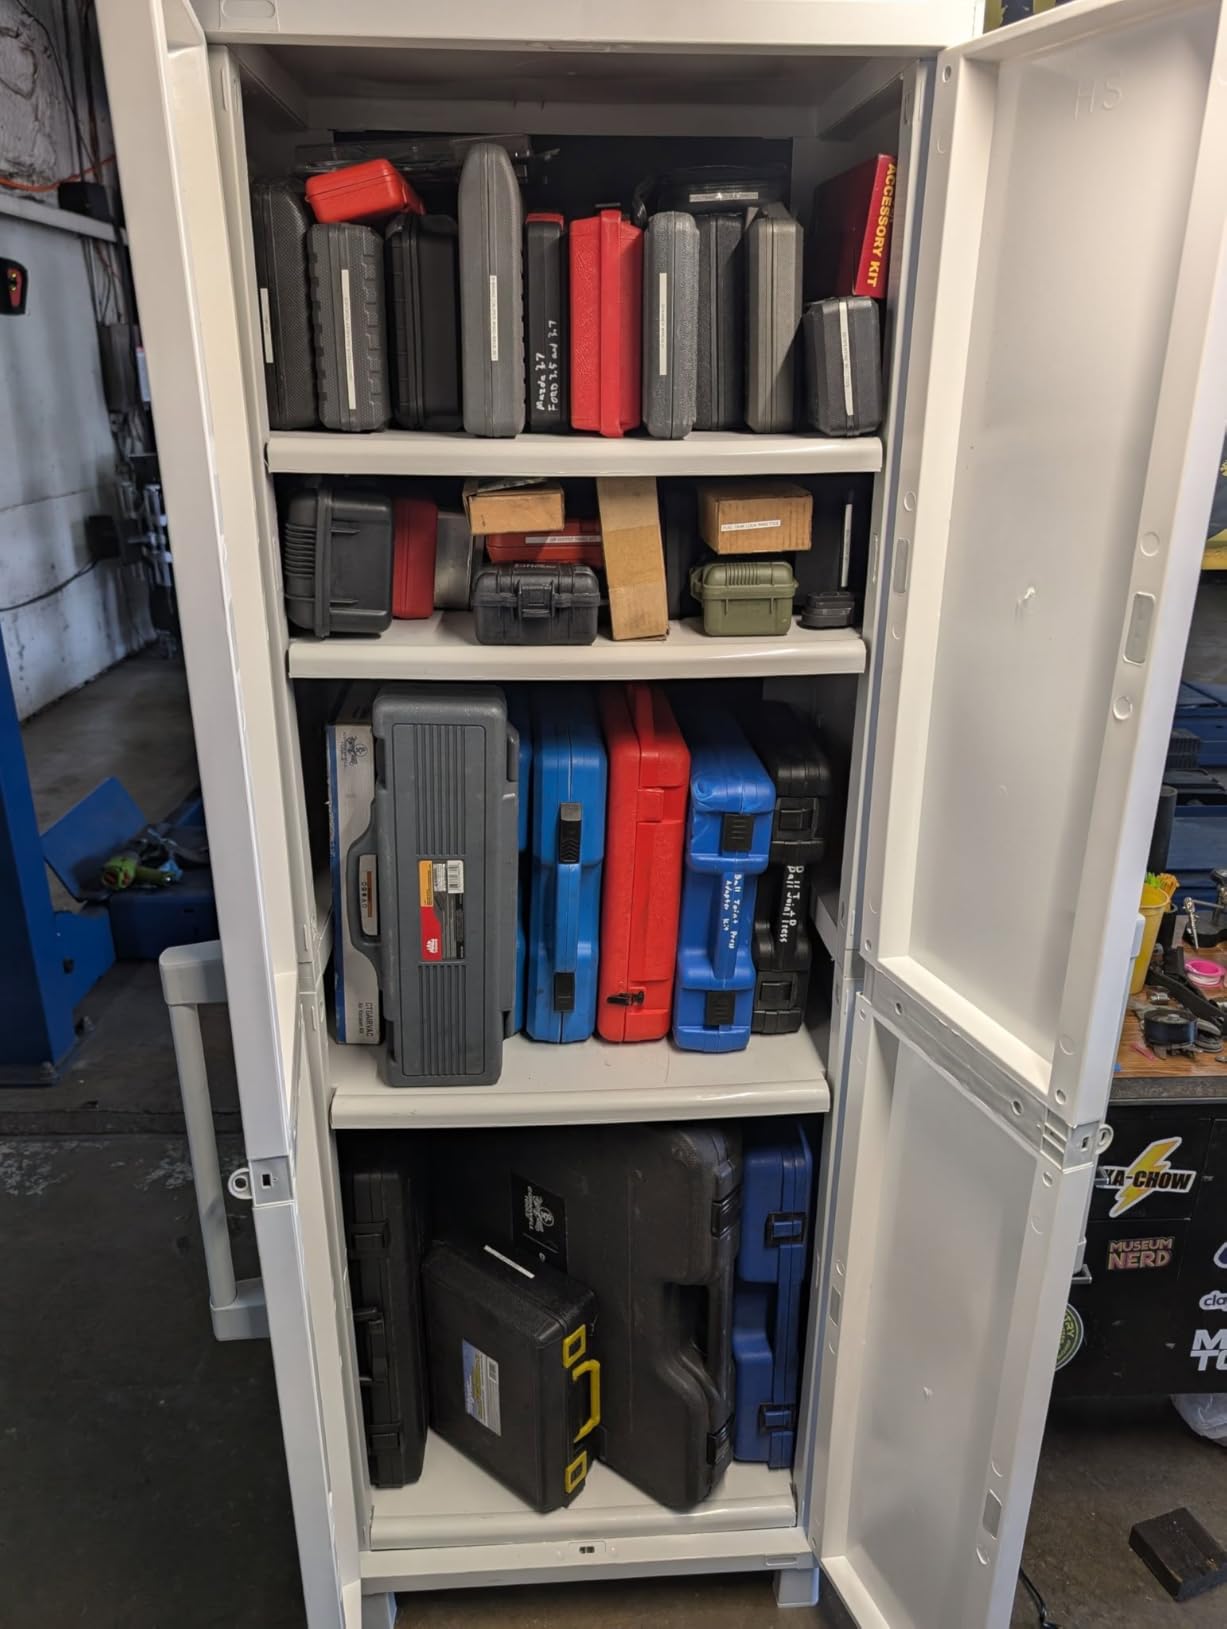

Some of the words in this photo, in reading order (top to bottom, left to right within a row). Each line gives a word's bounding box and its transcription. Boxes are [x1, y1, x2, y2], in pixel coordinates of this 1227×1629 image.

[872, 163, 896, 257] ACCESSORY
[866, 260, 881, 288] KIT
[549, 343, 558, 359] and
[535, 374, 546, 411] Mazda
[547, 383, 559, 411] FORD
[733, 873, 743, 893] Ball
[732, 899, 741, 925] Joint
[722, 918, 730, 932] Kit
[1110, 1239, 1173, 1252] MUSEUM
[1107, 1250, 1171, 1271] NERD
